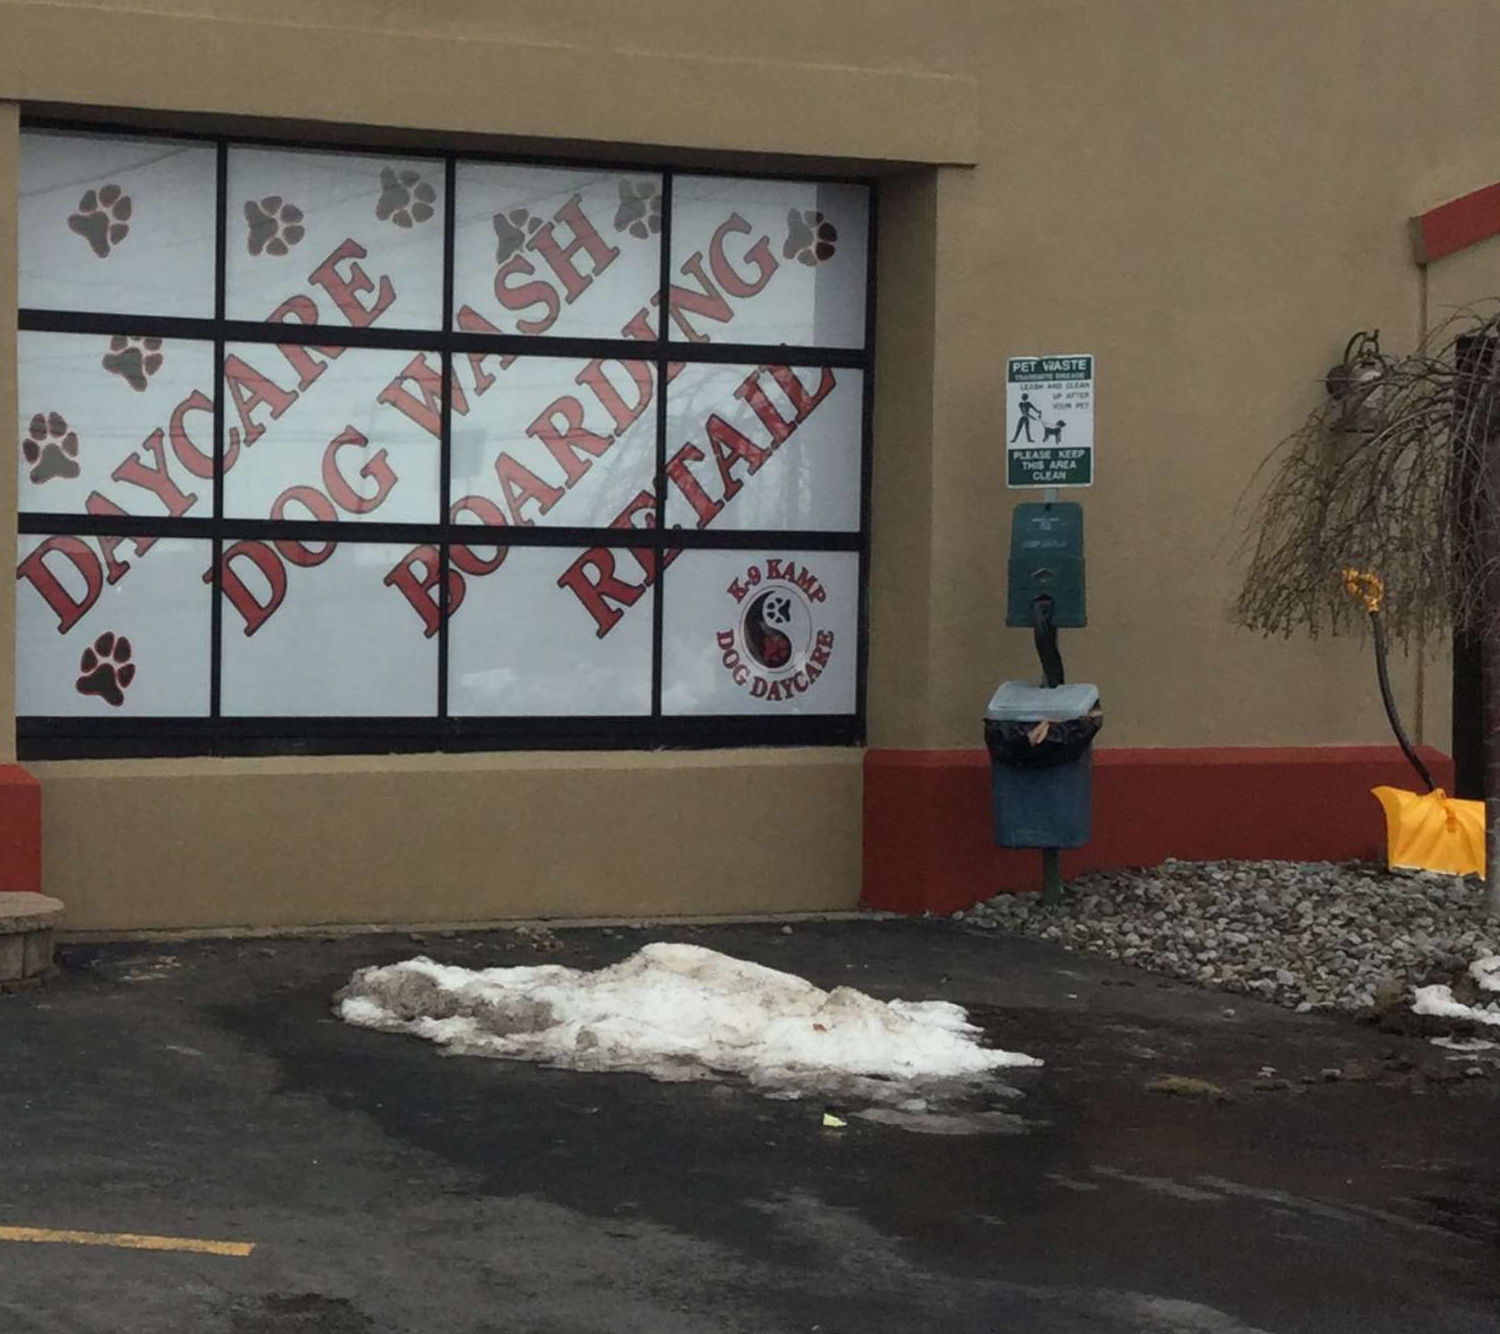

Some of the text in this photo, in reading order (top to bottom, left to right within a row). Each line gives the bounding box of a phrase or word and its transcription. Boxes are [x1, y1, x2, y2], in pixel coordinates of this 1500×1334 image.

[1012, 359, 1087, 372] PET WASTE
[16, 238, 397, 635] DAYCARE
[202, 194, 621, 637] DOG WASH
[384, 212, 779, 639] BOARDING
[1012, 449, 1086, 460] PLEASE KEEP
[1022, 460, 1077, 470] THIS AREA
[1032, 471, 1067, 481] CLEAN
[557, 344, 837, 639] RETAIL
[727, 559, 827, 603] K-9 KAMP
[716, 629, 835, 701] DOG DAYCARE
